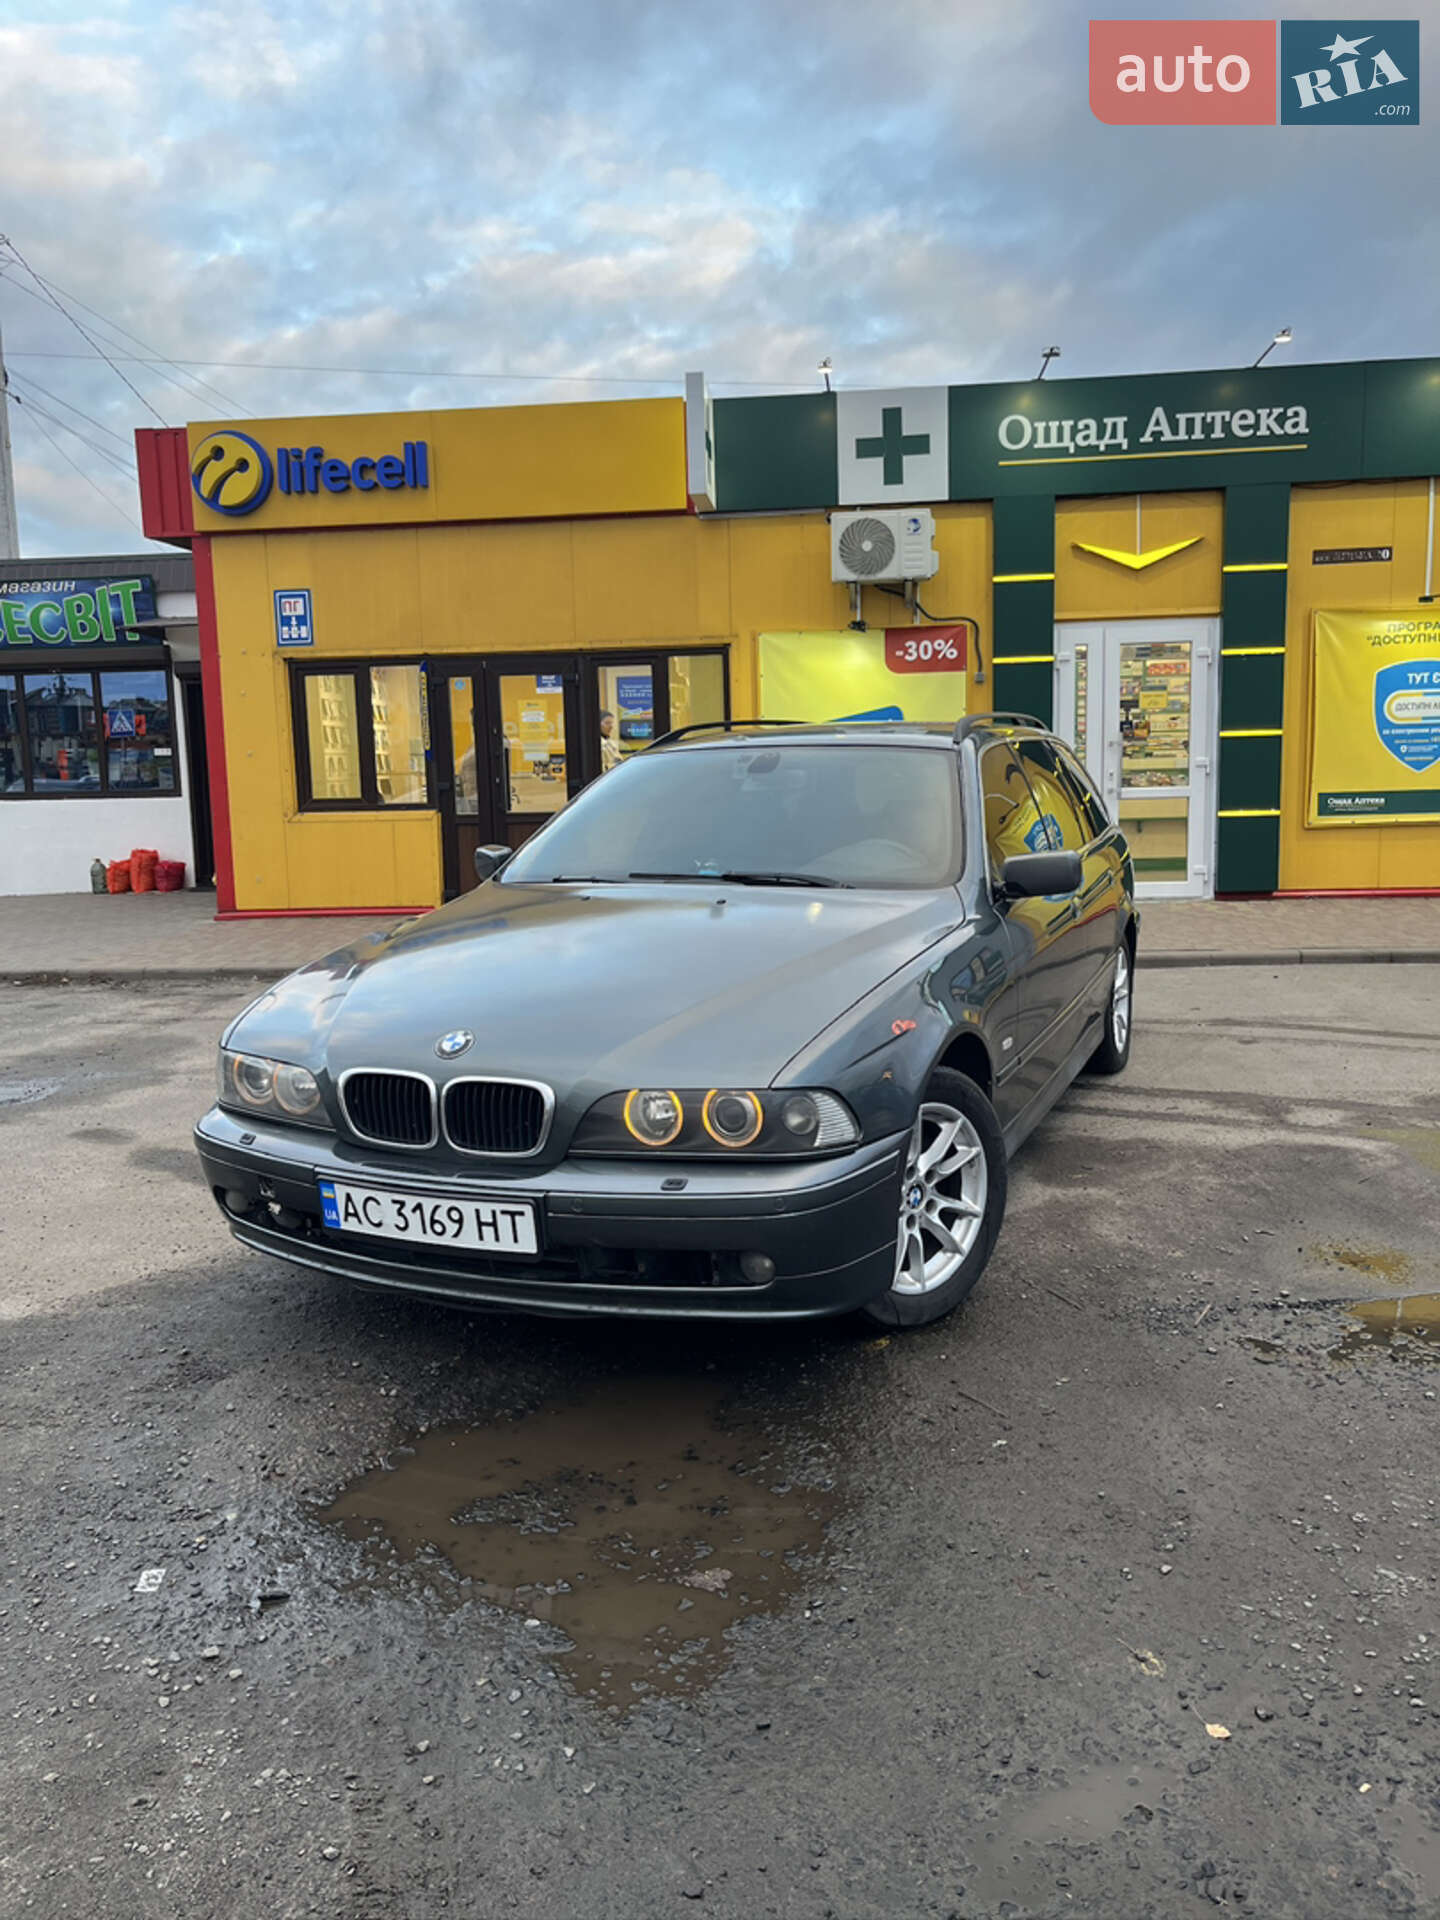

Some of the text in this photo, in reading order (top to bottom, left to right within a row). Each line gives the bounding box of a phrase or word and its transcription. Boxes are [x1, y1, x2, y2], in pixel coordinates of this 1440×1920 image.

[998, 404, 1309, 454] Ощад Аптека
[276, 441, 429, 495] lifecell
[0, 579, 142, 644] ЕСВІТ
[895, 639, 958, 662] -30%
[1407, 672, 1429, 685] ТУТ
[324, 1208, 339, 1221] UA
[343, 1192, 526, 1244] AC 3169 HT
